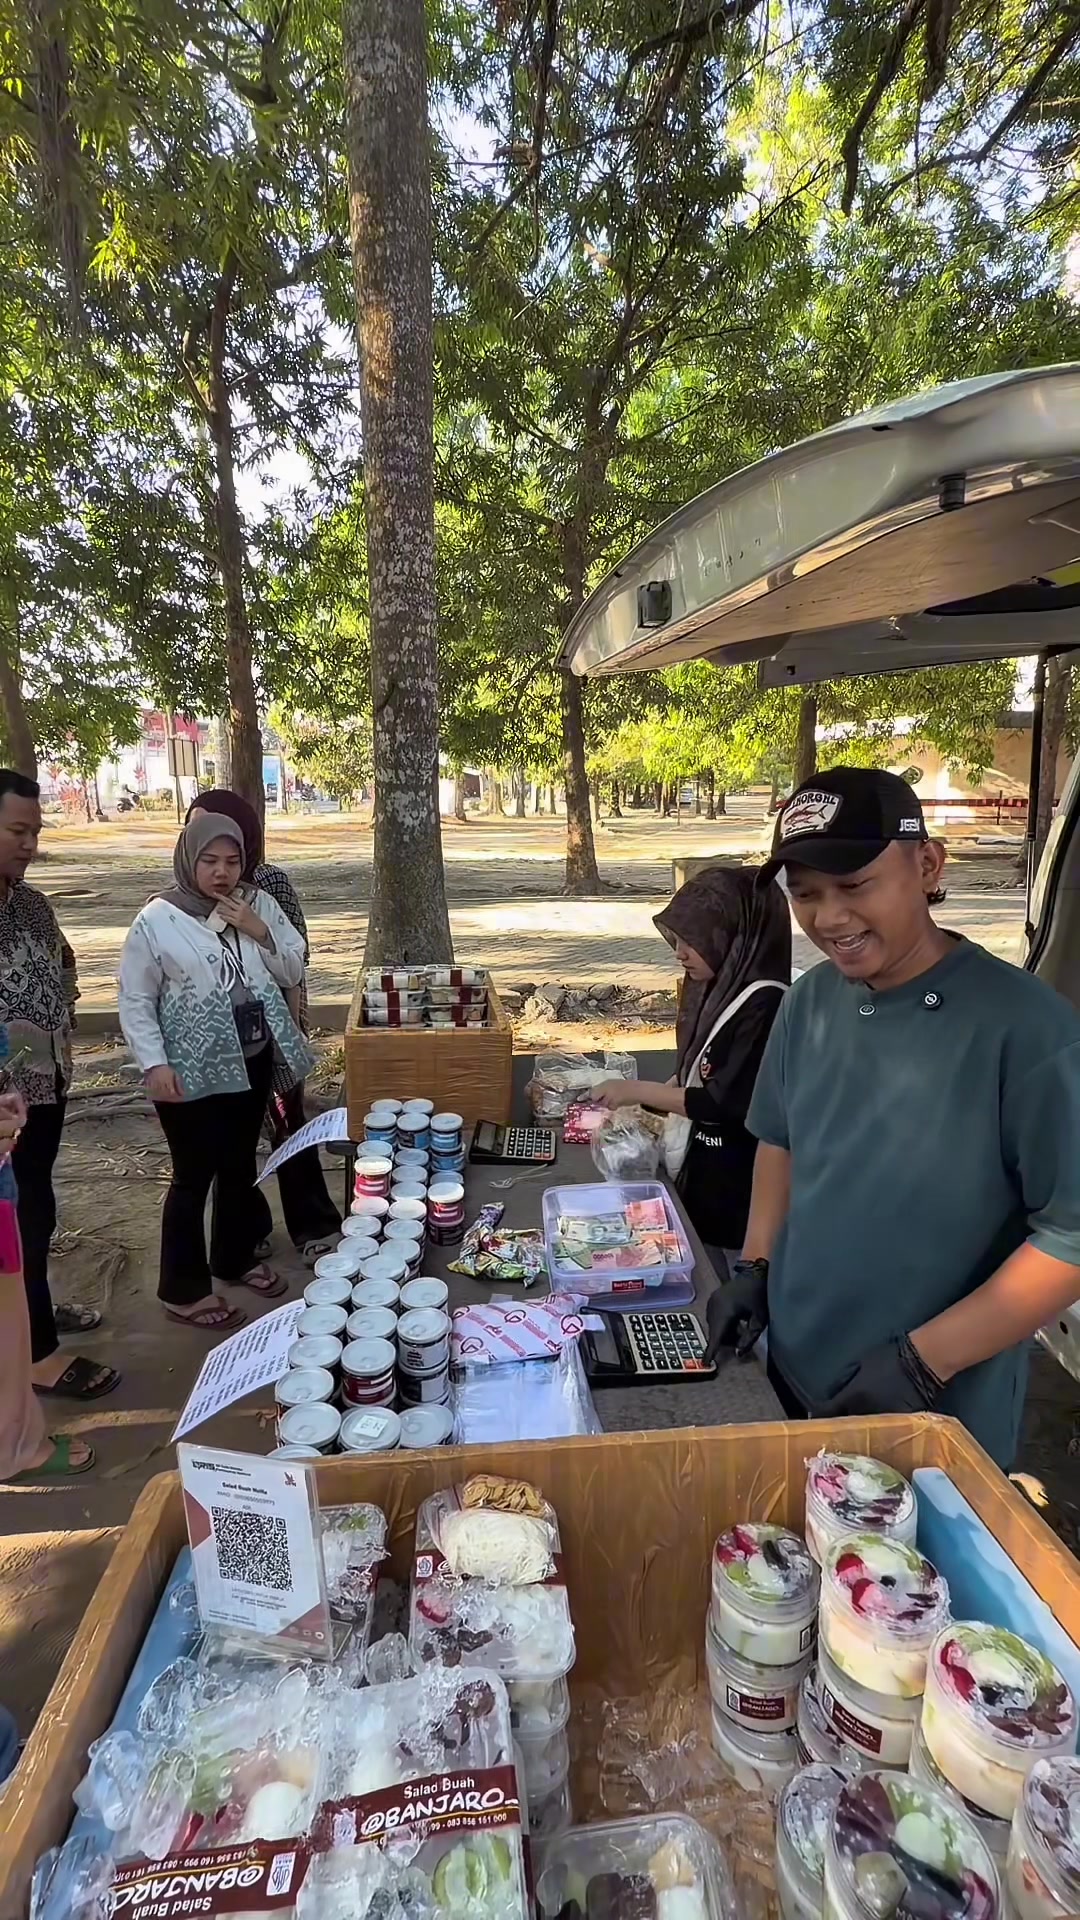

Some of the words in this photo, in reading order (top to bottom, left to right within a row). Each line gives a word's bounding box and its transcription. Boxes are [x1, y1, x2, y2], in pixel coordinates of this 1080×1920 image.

[404, 1782, 438, 1799] Salad
[442, 1777, 475, 1791] Buah
[447, 1817, 461, 1828] 083
[184, 1857, 199, 1867] 999
[133, 1903, 168, 1920] Buah
[172, 1897, 213, 1915] Salad
